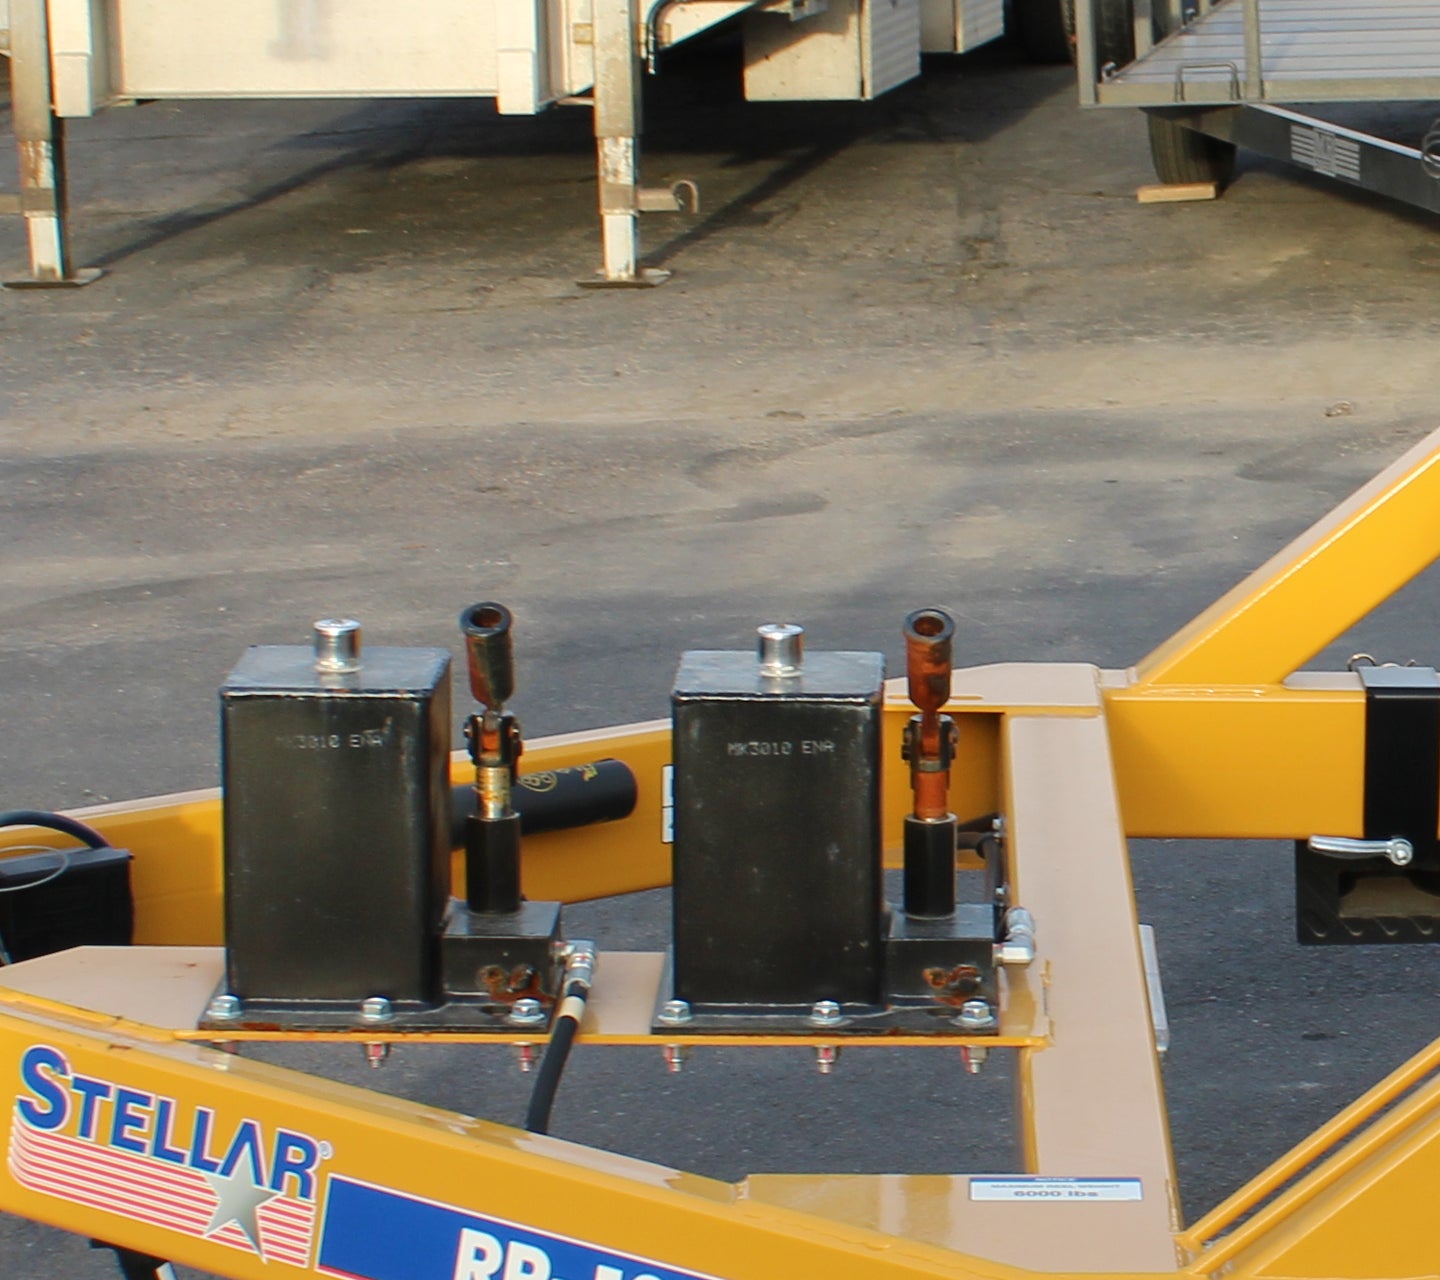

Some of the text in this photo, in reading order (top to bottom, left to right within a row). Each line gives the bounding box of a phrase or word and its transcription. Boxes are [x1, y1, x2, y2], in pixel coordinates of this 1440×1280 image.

[727, 740, 835, 756] MK3010 ENA
[19, 1044, 319, 1199] STELLAR
